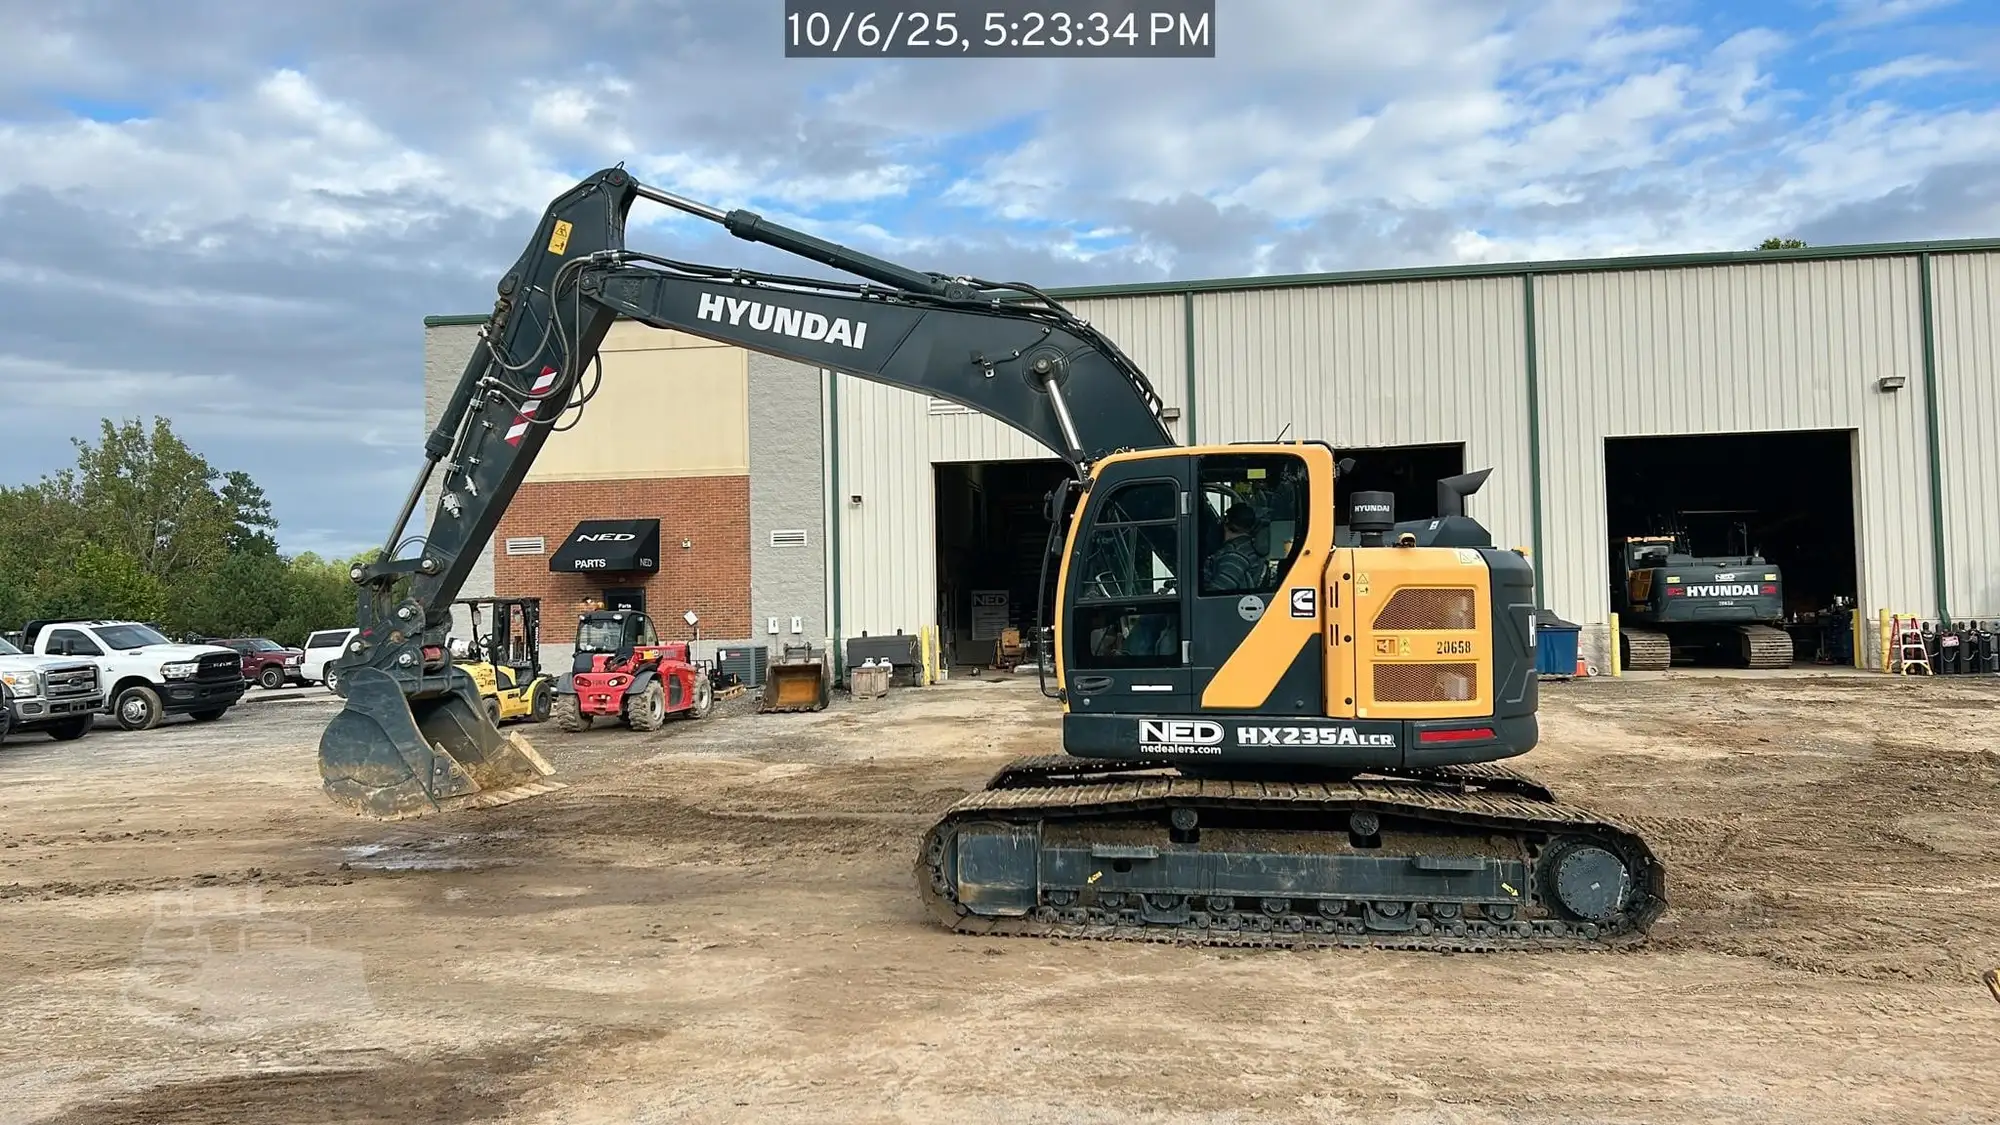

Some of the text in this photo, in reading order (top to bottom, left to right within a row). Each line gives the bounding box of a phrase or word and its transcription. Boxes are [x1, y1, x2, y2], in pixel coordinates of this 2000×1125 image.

[697, 292, 867, 350] HYUNDAI
[1354, 504, 1390, 512] HYUNDAI
[576, 533, 636, 542] NED
[574, 558, 607, 569] PARTS
[640, 558, 653, 567] NED
[1686, 584, 1759, 597] HYUNDAI
[973, 593, 1007, 606] NED
[1436, 640, 1472, 654] 20658
[1140, 720, 1223, 744] NED
[1140, 744, 1222, 755] nedealers.com
